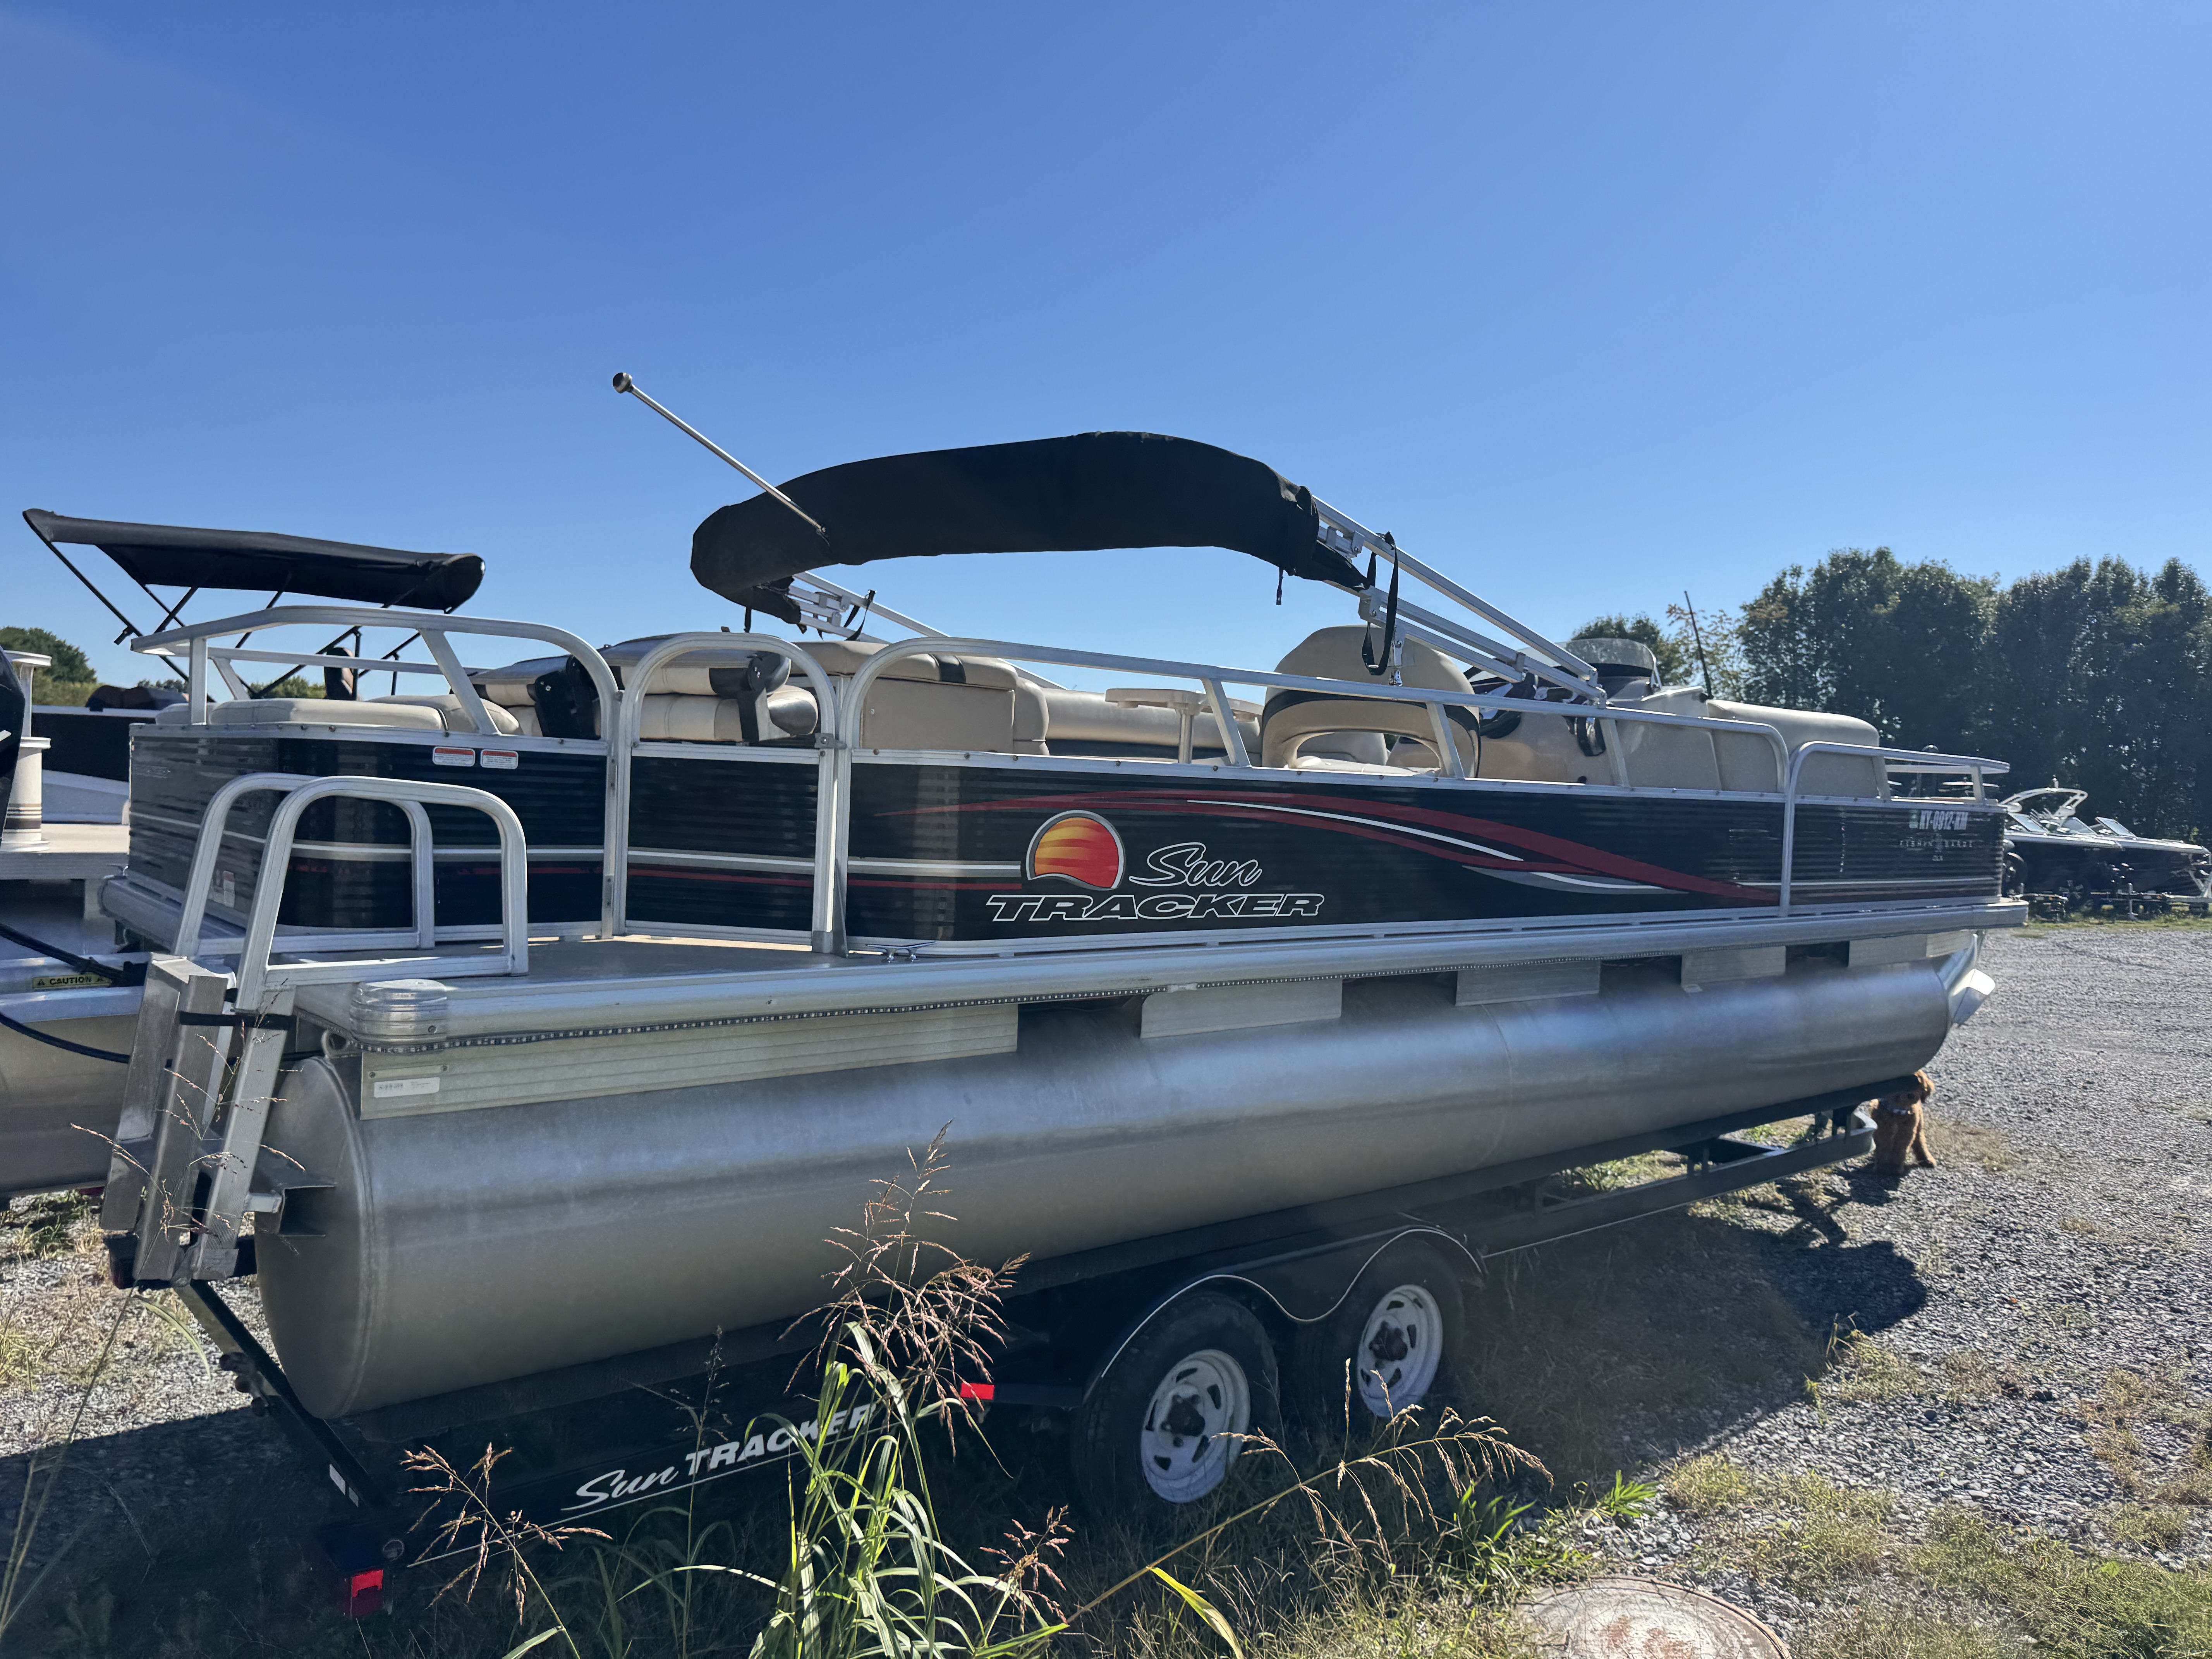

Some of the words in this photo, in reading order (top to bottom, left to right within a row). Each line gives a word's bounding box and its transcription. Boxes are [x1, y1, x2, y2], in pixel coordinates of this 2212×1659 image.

[1128, 842, 1262, 887] Sun
[986, 893, 1325, 922] TRACKER
[49, 976, 92, 985] CAUTION
[560, 1466, 678, 1511] Sun
[685, 1403, 877, 1476] TRACKER
